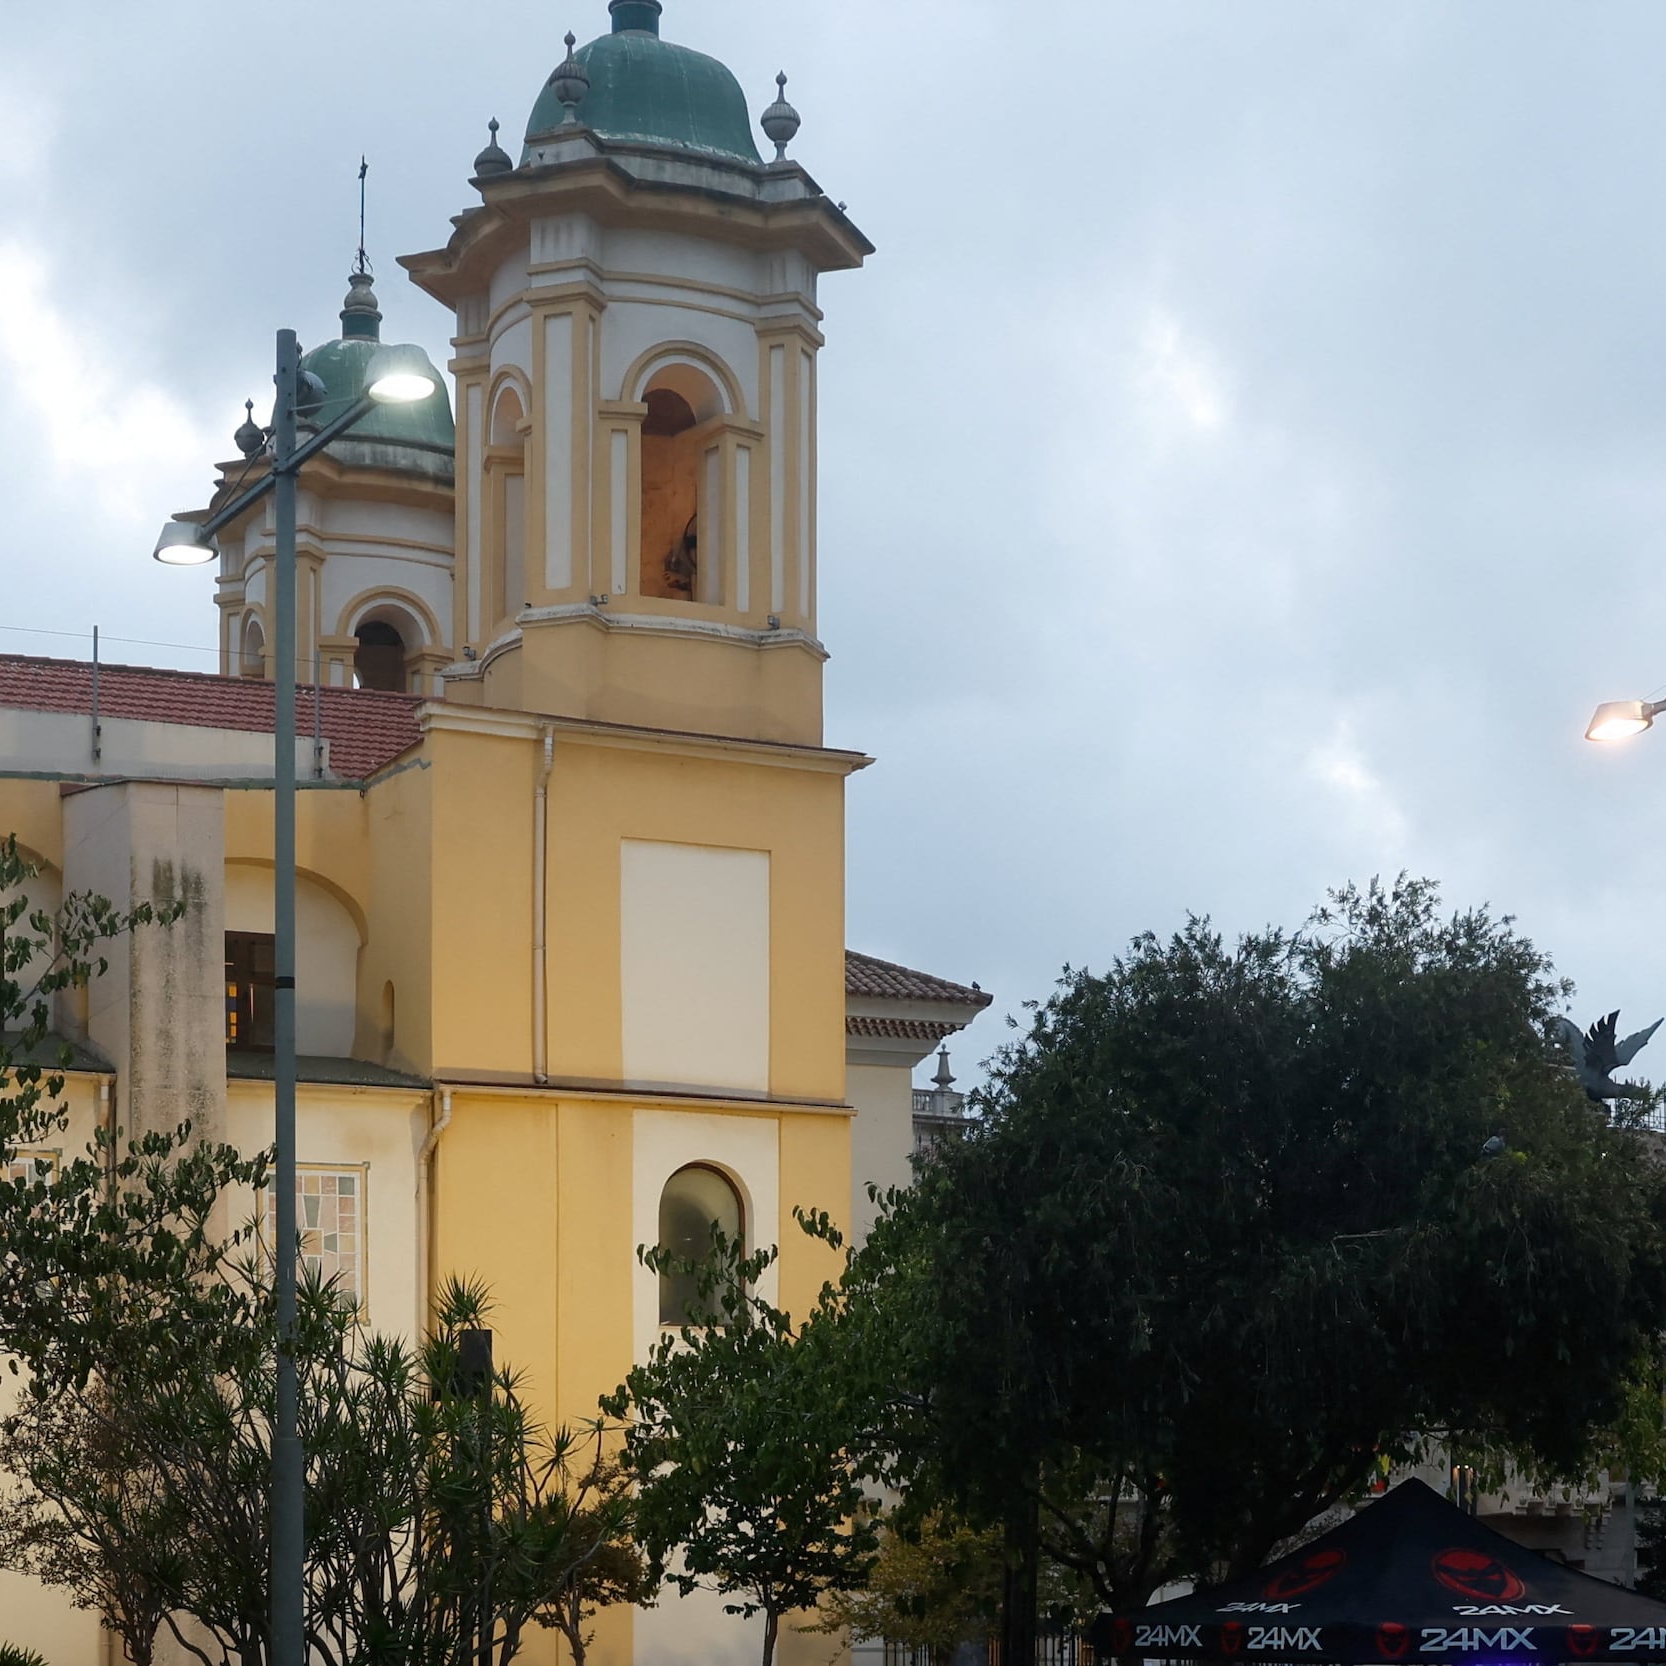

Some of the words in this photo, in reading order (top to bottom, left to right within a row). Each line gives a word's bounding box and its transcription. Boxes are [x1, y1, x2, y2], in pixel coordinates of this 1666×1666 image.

[1215, 1600, 1302, 1615] 24MX
[1452, 1604, 1575, 1616] 24MX
[1134, 1624, 1204, 1648] 24MX
[1246, 1626, 1324, 1651] 24MX
[1419, 1626, 1539, 1652] 24MX
